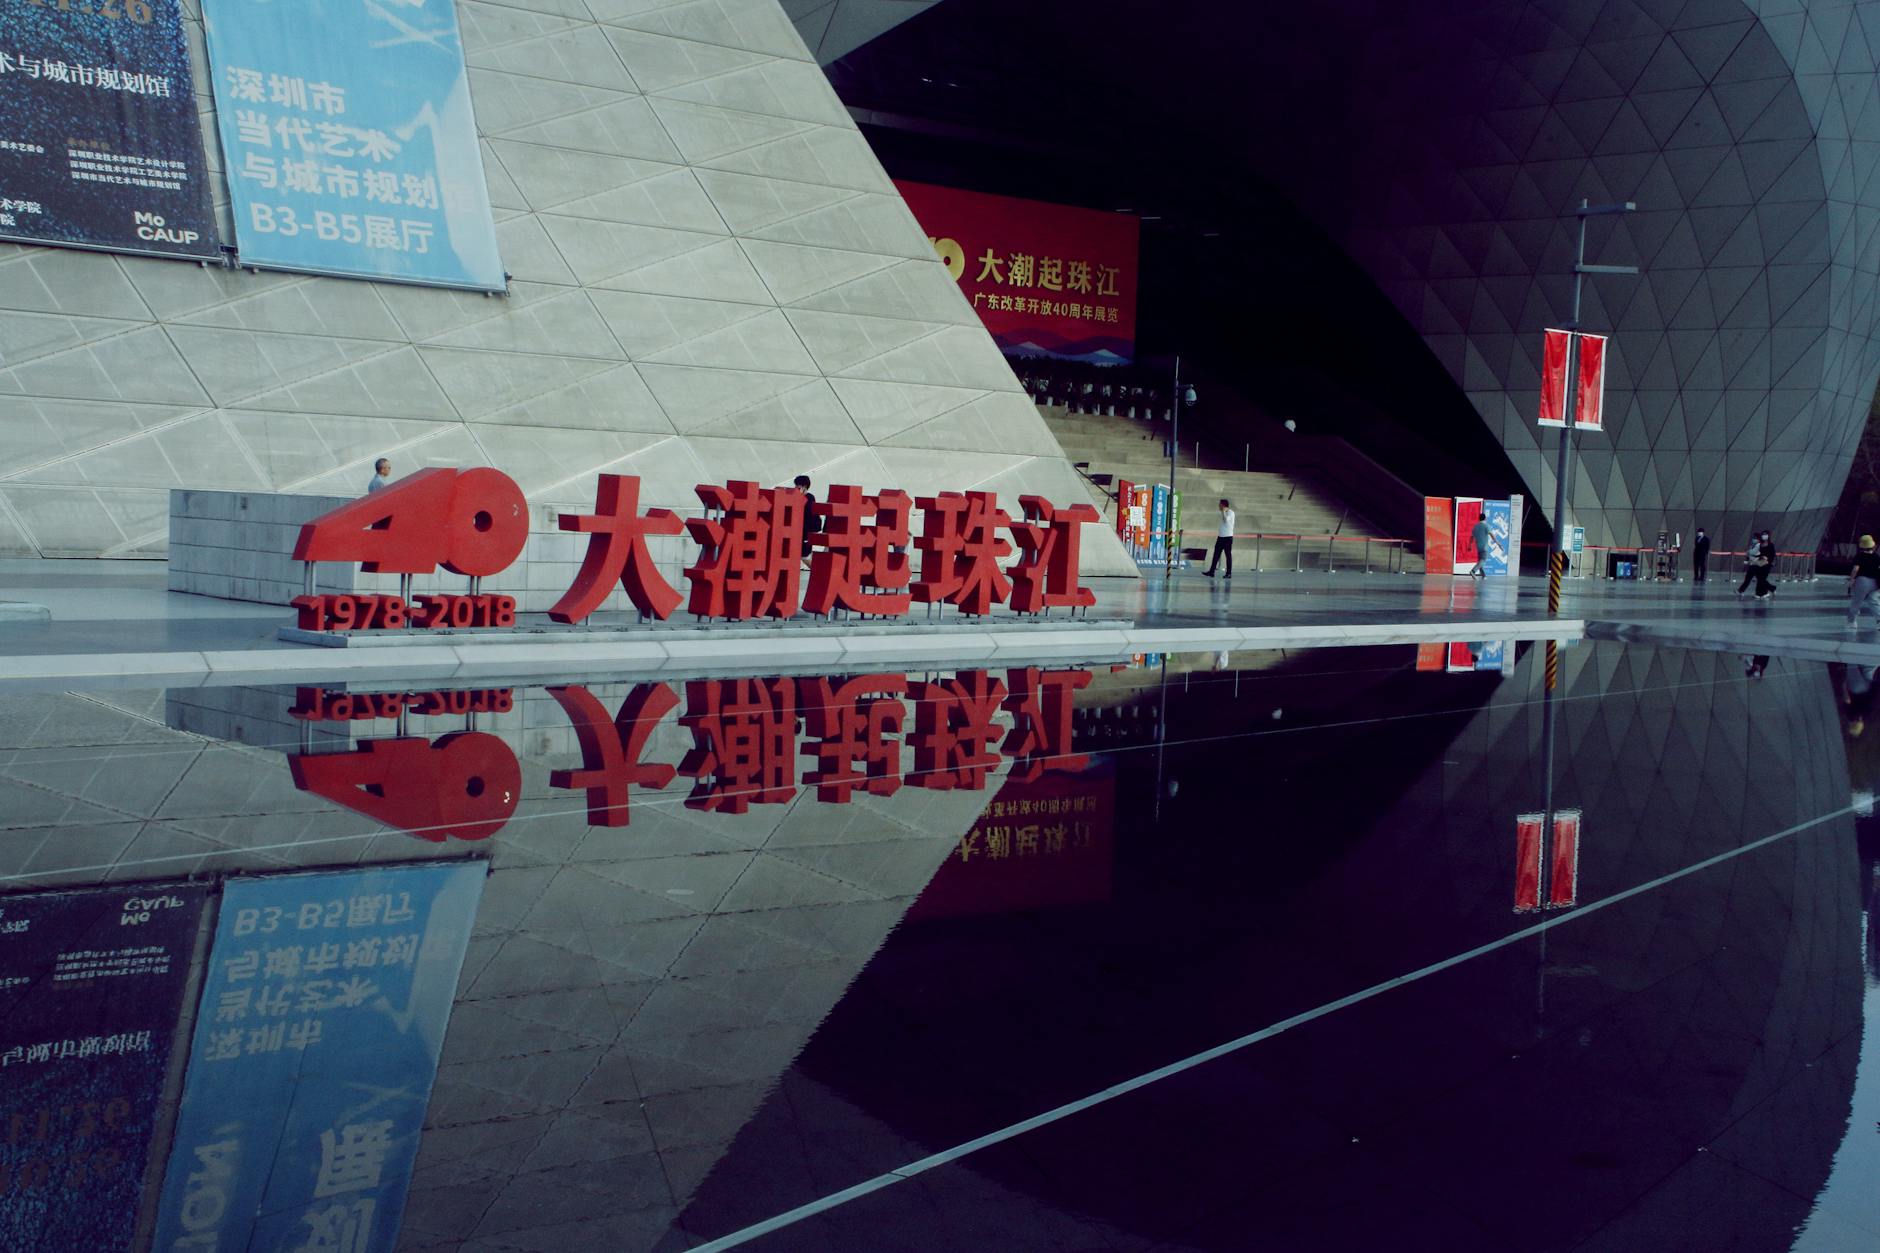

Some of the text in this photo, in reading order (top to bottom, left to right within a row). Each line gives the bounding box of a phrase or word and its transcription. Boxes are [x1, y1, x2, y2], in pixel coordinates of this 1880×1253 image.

[226, 65, 345, 115] 深圳市
[236, 110, 400, 162] 当代艺术
[137, 226, 199, 244] CAUP
[251, 202, 433, 253] B3-B5展厅
[976, 248, 1120, 296] 大潮起珠江
[974, 292, 1119, 323] 广东改革开放40周年展览
[291, 467, 530, 577] 40
[547, 473, 1100, 624] 大潮起珠江
